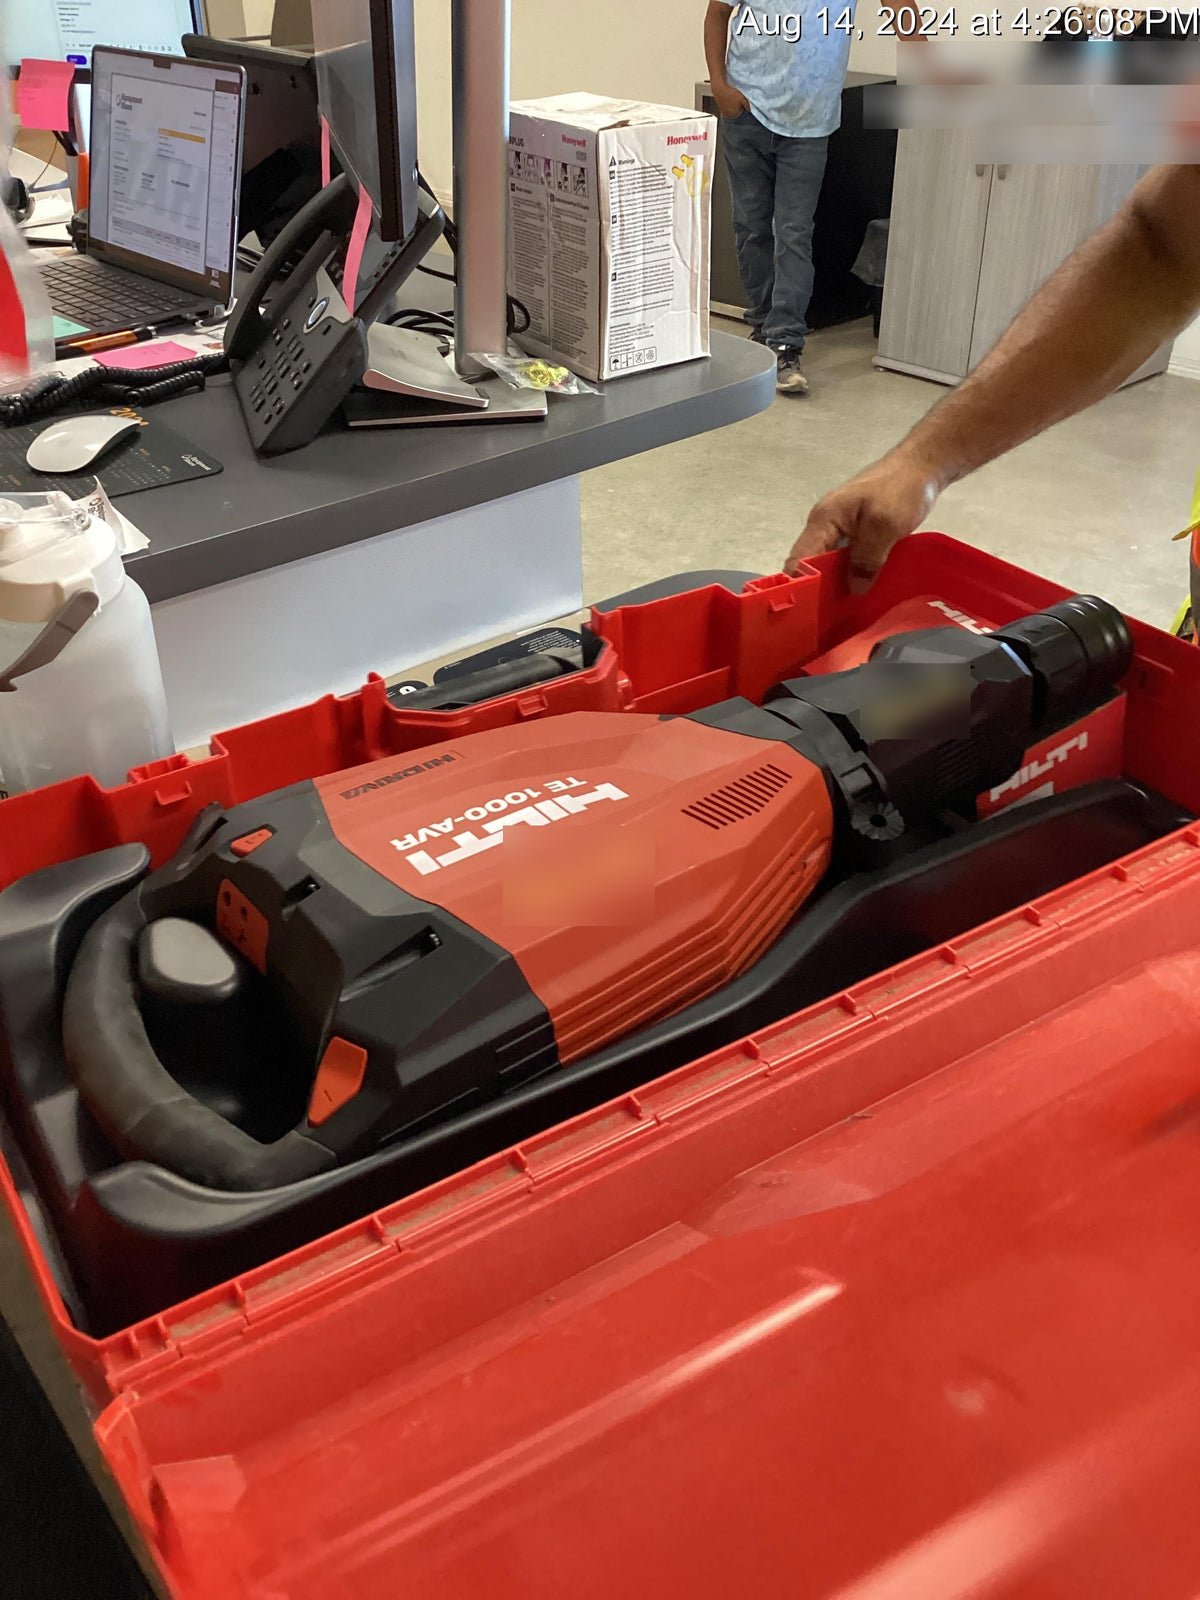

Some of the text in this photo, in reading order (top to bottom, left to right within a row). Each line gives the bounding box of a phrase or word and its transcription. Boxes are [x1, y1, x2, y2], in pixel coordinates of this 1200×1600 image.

[561, 134, 587, 148] Honeywell
[667, 131, 708, 146] Honeywell
[926, 600, 995, 635] HIL
[990, 731, 1088, 802] HILTI
[390, 776, 588, 851] TE 1000-AVR
[405, 782, 630, 875] HILTI
